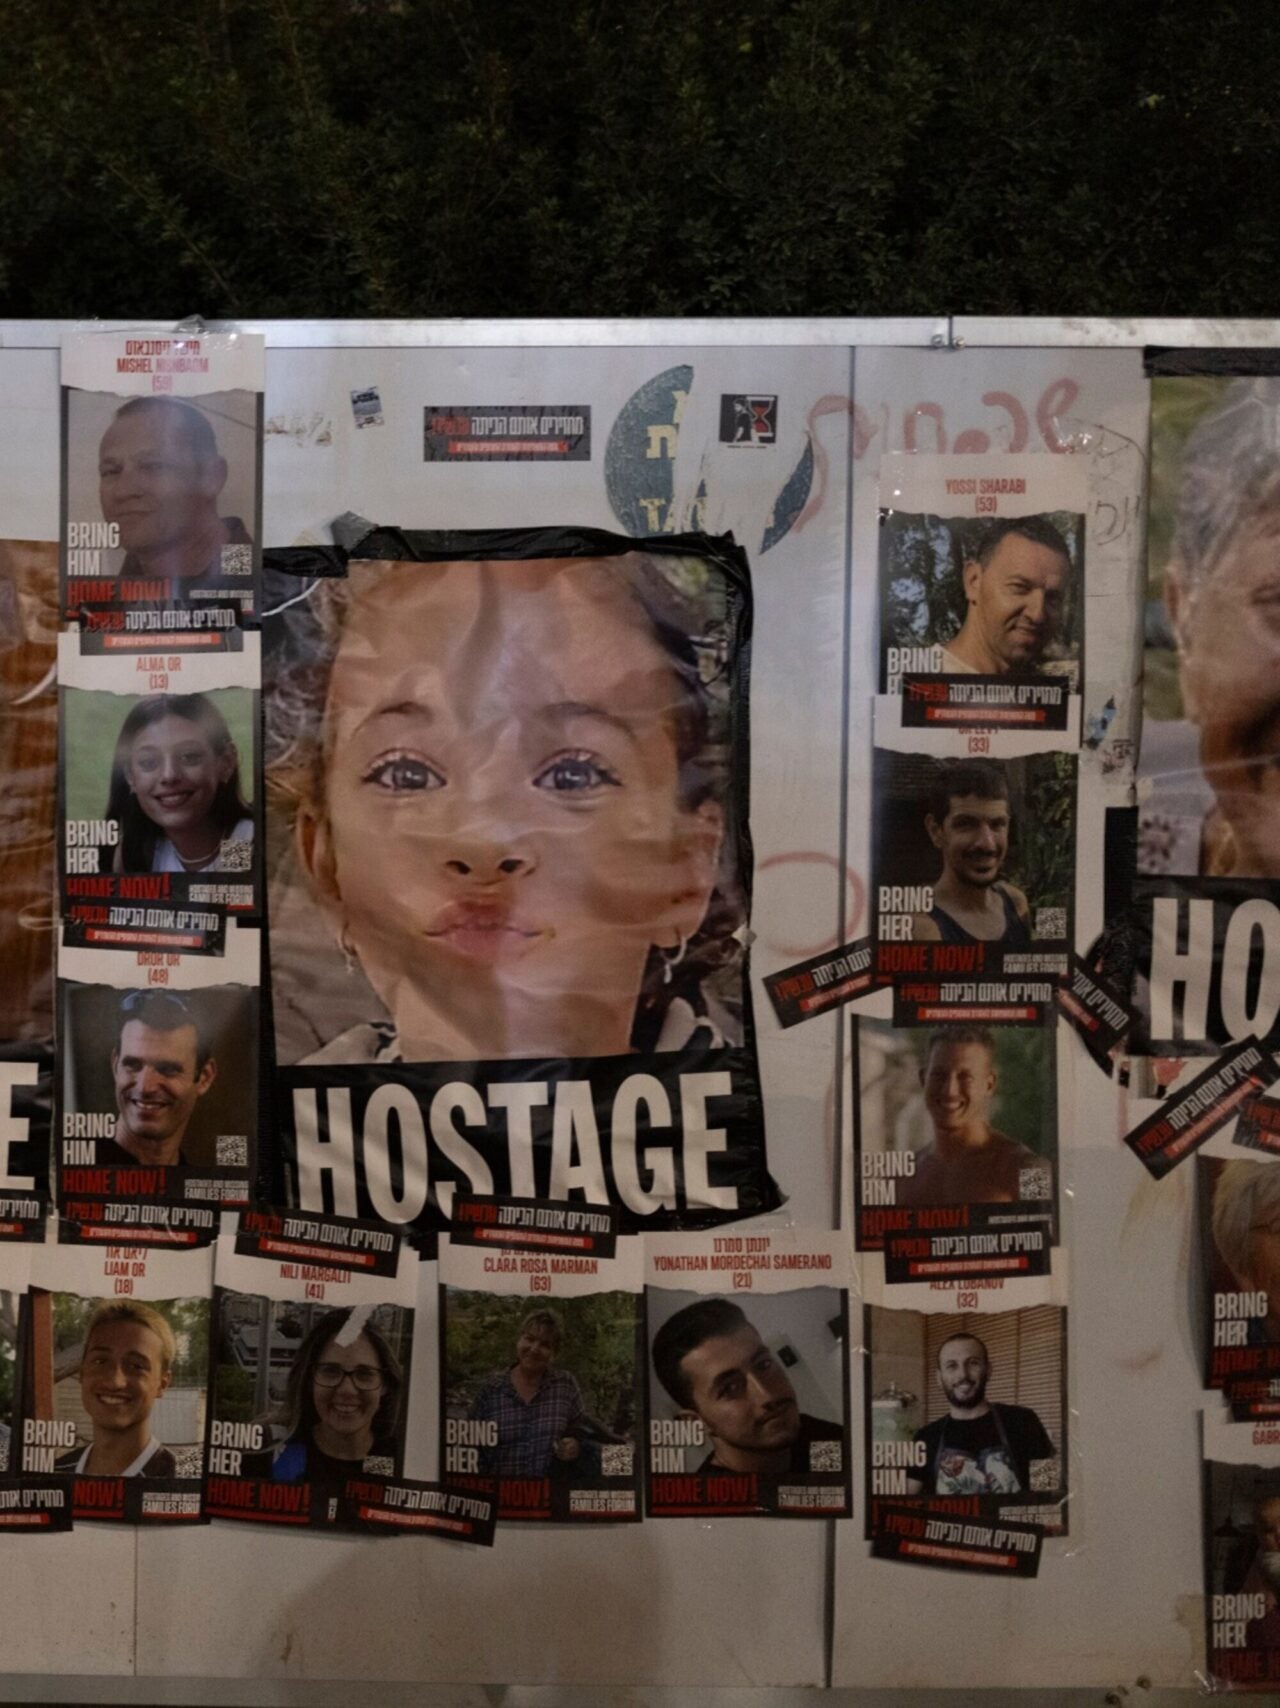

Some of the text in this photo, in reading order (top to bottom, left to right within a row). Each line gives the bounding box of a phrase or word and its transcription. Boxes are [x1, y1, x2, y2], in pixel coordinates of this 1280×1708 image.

[117, 358, 152, 373] MISHEL
[945, 479, 1026, 494] YOSSI SHARABI
[975, 496, 998, 513] (53)
[67, 521, 121, 549] BRING
[67, 550, 102, 576] HIM
[136, 656, 182, 672] ALMA OR
[887, 647, 943, 674] BRING
[149, 673, 169, 691] (13)
[967, 735, 990, 754] (33)
[65, 819, 119, 847] BRING
[65, 848, 101, 874] HER
[65, 872, 170, 901] HOME NOW!
[878, 886, 934, 913] BRING
[878, 914, 913, 941] HER
[877, 941, 985, 974] HOME NOW!
[148, 967, 169, 985] (48)
[63, 1112, 116, 1139] BRING
[62, 1140, 97, 1166] HIM
[292, 1070, 738, 1224] HOSTAGE
[862, 1150, 916, 1178] BRING
[62, 1167, 168, 1196] HOME NOW!
[862, 1179, 896, 1206] HIM
[104, 1261, 146, 1277] LIAM OR
[280, 1264, 352, 1284] NILI MARGALIT
[484, 1257, 598, 1274] CLARA ROSA MARMAN
[653, 1254, 832, 1271] YONATHAN MORDECHAI SAMERANO
[114, 1278, 134, 1295] (18)
[305, 1283, 325, 1300] (41)
[530, 1274, 552, 1292] (63)
[732, 1272, 753, 1289] (21)
[956, 1292, 978, 1309] (32)
[1213, 1291, 1269, 1320] BRING
[1213, 1320, 1249, 1347] HER
[23, 1417, 76, 1447] BRING
[210, 1419, 264, 1450] BRING
[446, 1418, 499, 1447] BRING
[650, 1418, 705, 1446] BRING
[22, 1446, 55, 1474] HIM
[208, 1449, 243, 1477] HER
[445, 1446, 479, 1474] HER
[650, 1447, 685, 1474] HIM
[872, 1440, 927, 1467] BRING
[73, 1477, 126, 1508] NOW!
[207, 1476, 312, 1513] HOME NOW!
[499, 1472, 552, 1508] NOW!
[650, 1475, 703, 1504] HOME
[706, 1473, 758, 1505] NOW!
[871, 1469, 907, 1496] HIM
[1212, 1593, 1266, 1620] BRING
[1212, 1621, 1247, 1649] HER
